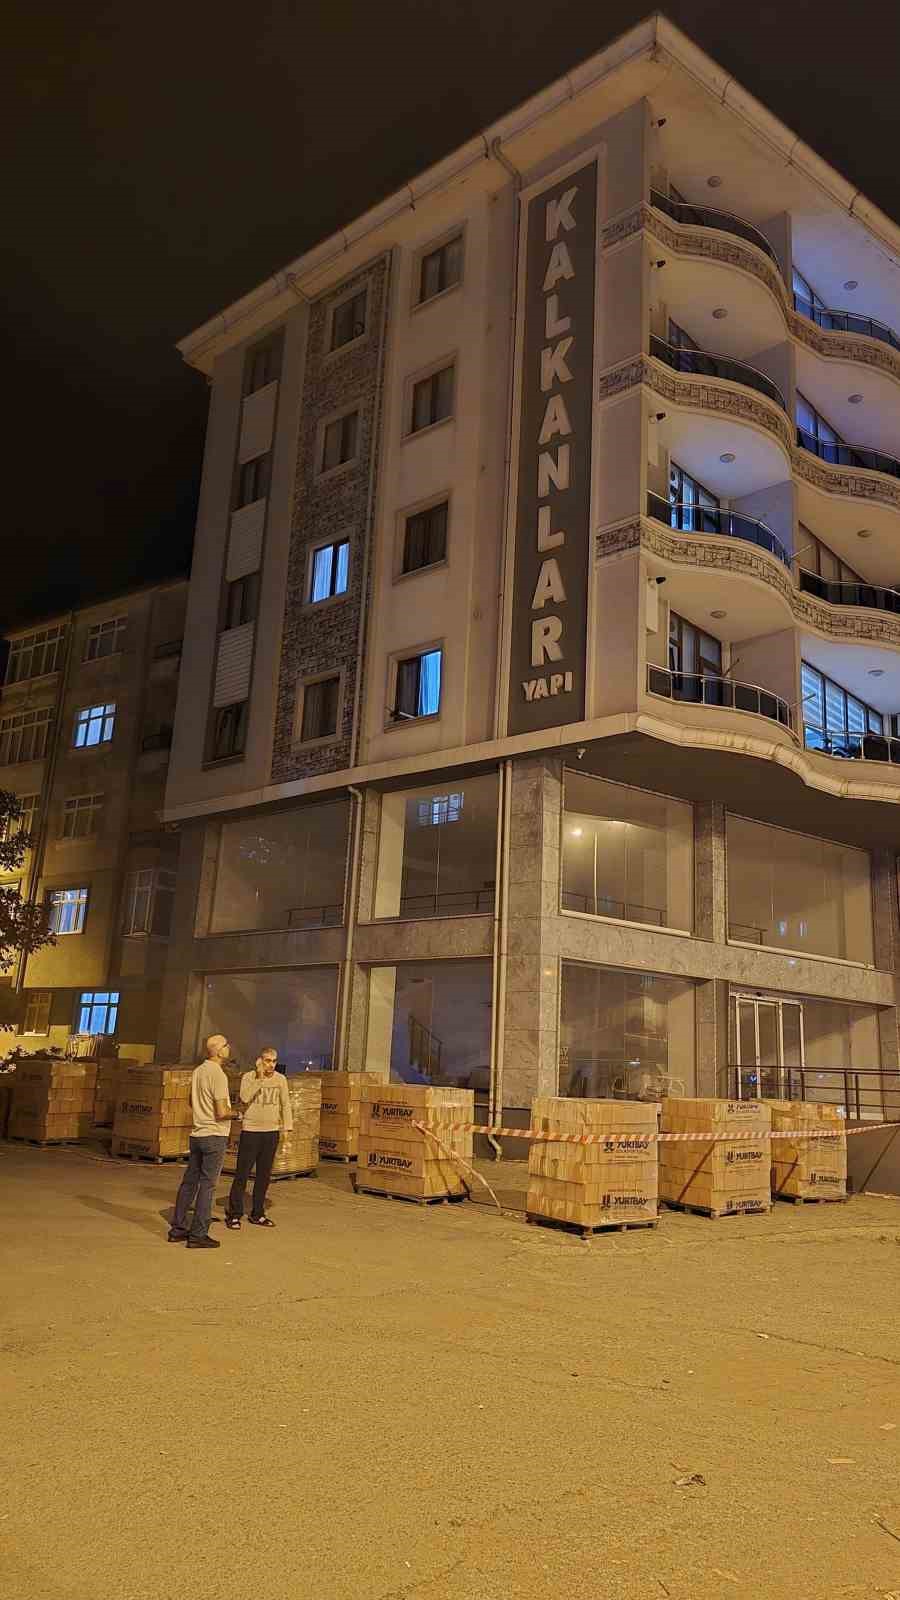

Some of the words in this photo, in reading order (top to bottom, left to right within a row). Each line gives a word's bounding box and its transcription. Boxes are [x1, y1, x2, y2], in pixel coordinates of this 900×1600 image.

[531, 186, 579, 667] KALKANLAR
[520, 671, 573, 702] YAPI
[383, 1106, 413, 1118] YURTBAY
[736, 1151, 763, 1160] YURTBAY
[379, 1156, 413, 1169] YURTBAY
[615, 1195, 649, 1206] YURTBAY
